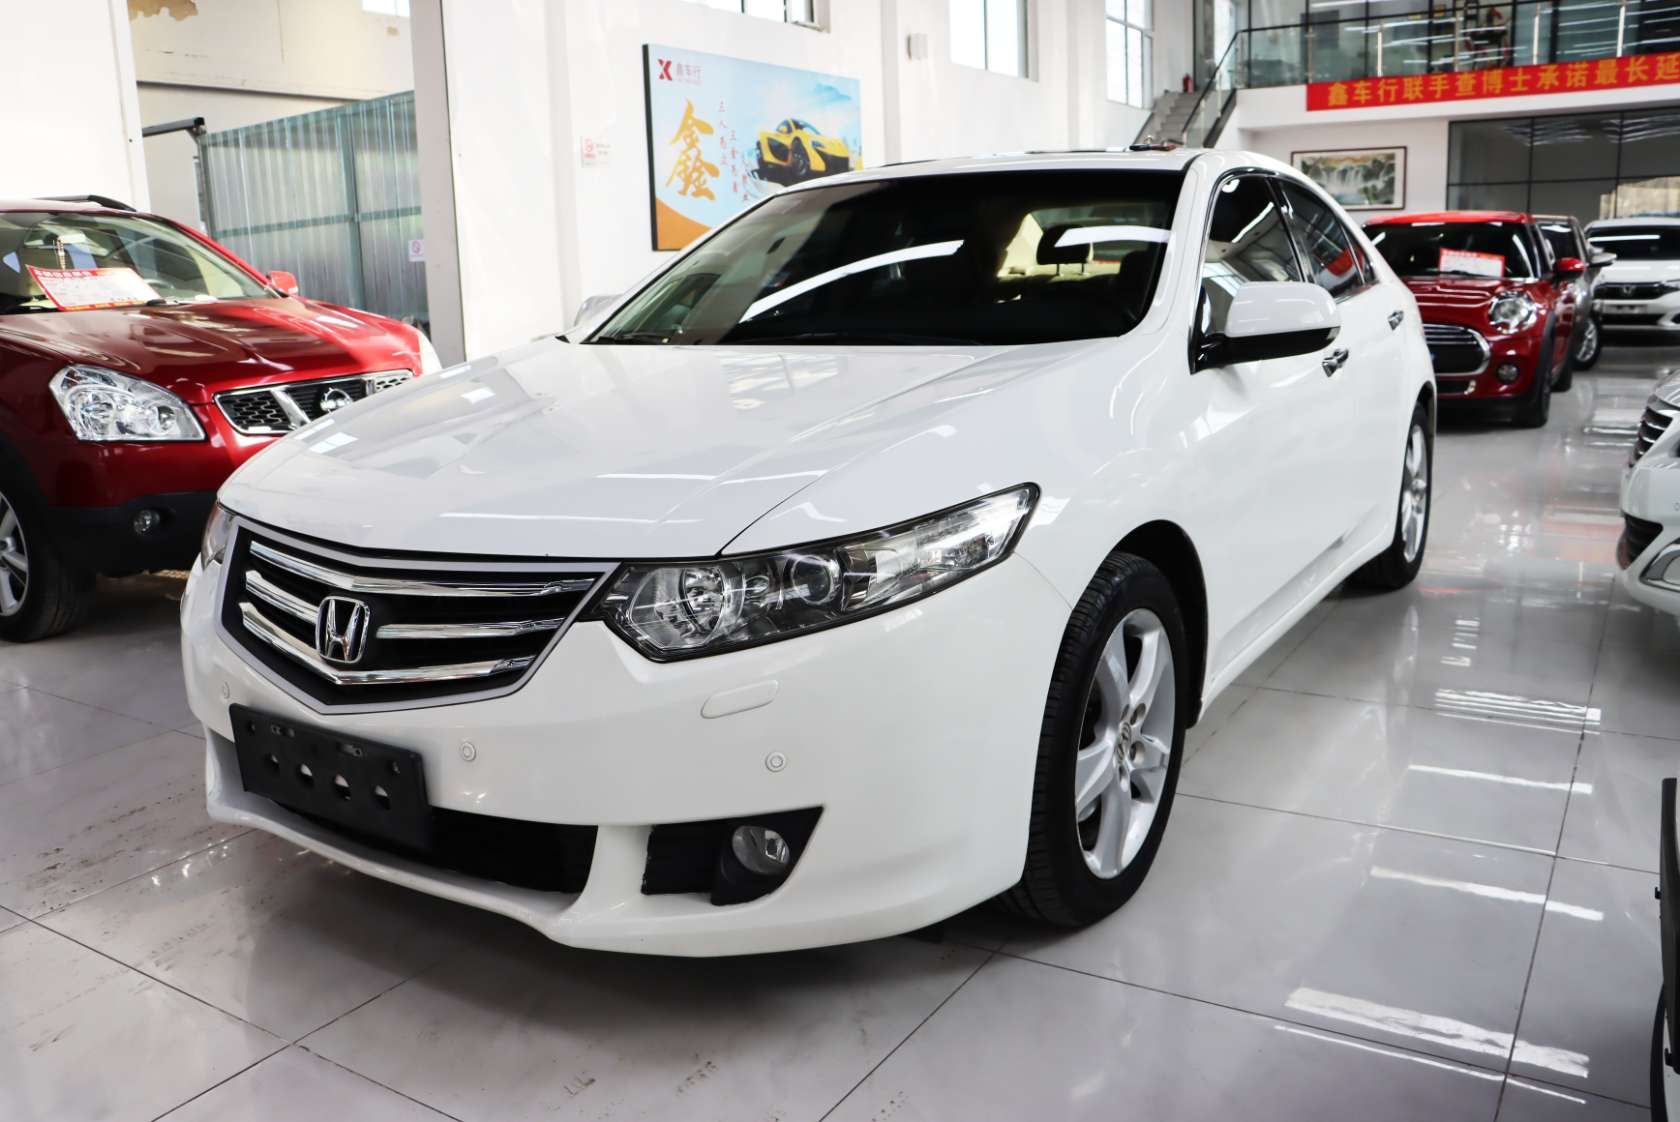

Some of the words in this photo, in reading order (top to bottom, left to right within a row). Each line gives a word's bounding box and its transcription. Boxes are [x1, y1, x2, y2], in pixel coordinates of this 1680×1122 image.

[1328, 51, 1680, 106] 鑫车行联手查博士承诺最长延
